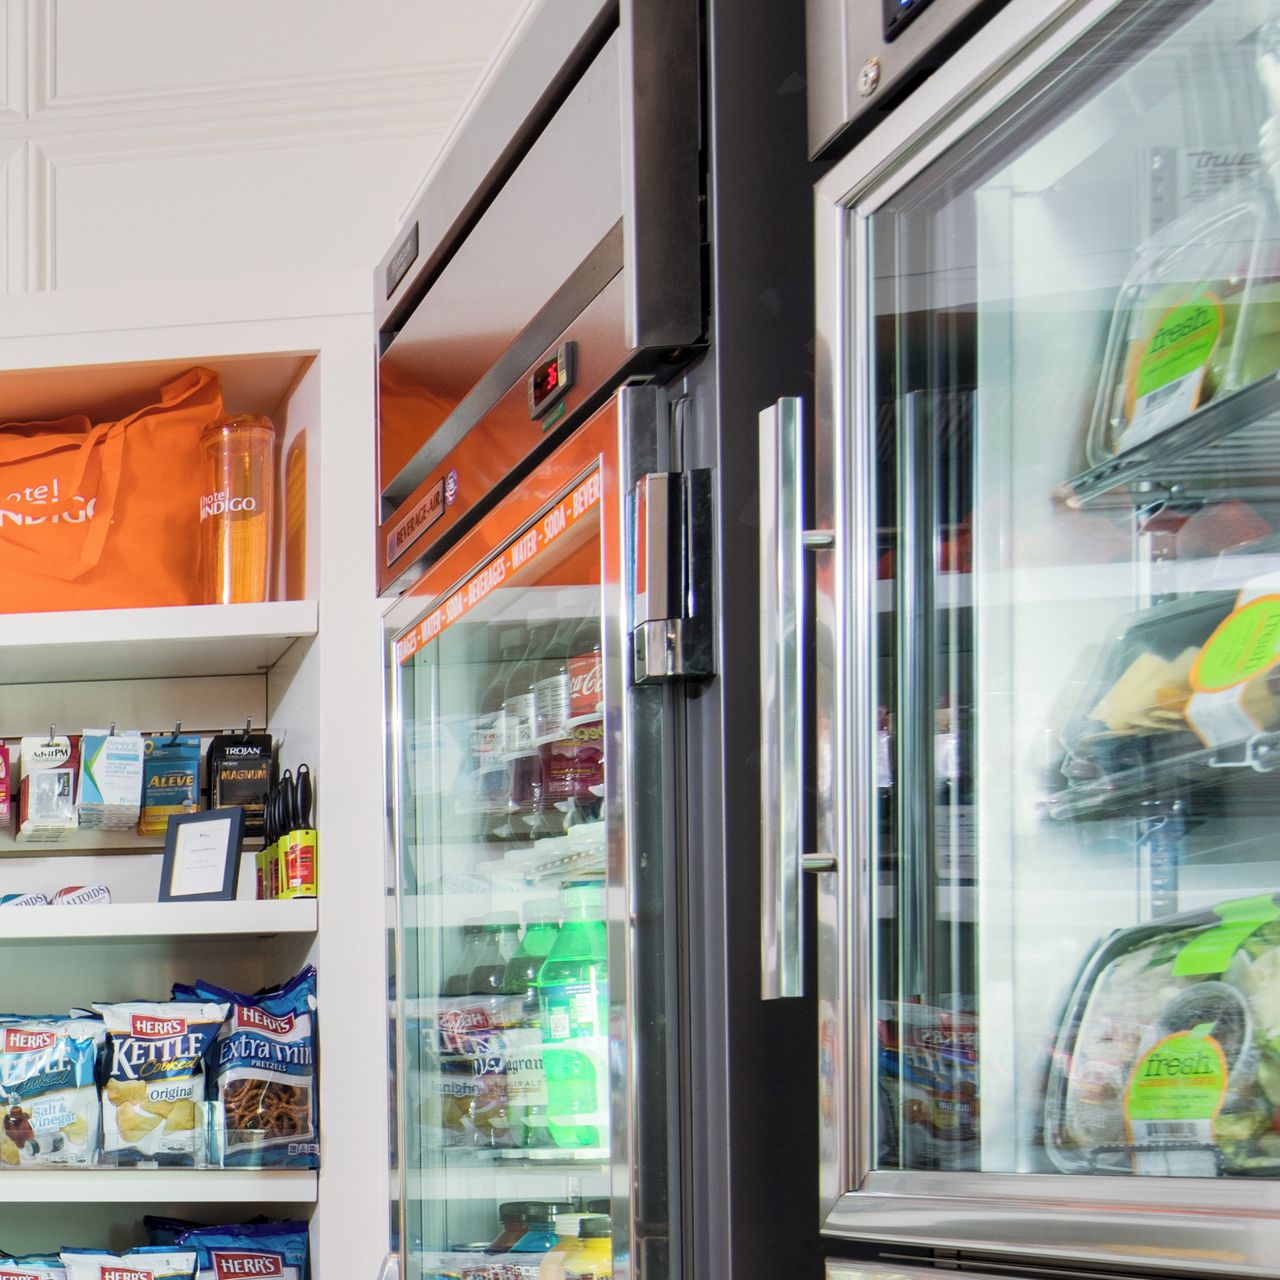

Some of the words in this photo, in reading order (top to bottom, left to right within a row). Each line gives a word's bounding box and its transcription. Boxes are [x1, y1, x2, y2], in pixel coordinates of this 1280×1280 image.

[396, 490, 441, 548] BEVERAGE-AIR
[446, 590, 464, 624] SODA
[468, 556, 506, 607] BEVERAGES
[512, 529, 538, 570] WATER
[543, 504, 567, 544] SODA
[55, 748, 69, 758] PM
[224, 747, 262, 756] TROJAN
[146, 775, 195, 789] ALEVE
[221, 769, 268, 781] MAGNUM
[135, 1019, 182, 1035] HERR'S
[242, 1006, 291, 1033] HERR'S
[8, 1032, 52, 1048] HERR'S
[219, 1034, 272, 1065] Extra
[271, 1043, 314, 1065] Thin
[110, 1032, 204, 1080] KETTLE
[250, 1058, 288, 1073] PRETZELS
[1143, 1053, 1215, 1077] fresh
[140, 1055, 200, 1078] Cooked
[13, 1067, 69, 1095] Cooked
[30, 1110, 78, 1130] Vinegar
[33, 1104, 57, 1118] Salt
[220, 1255, 276, 1274] HERR'S
